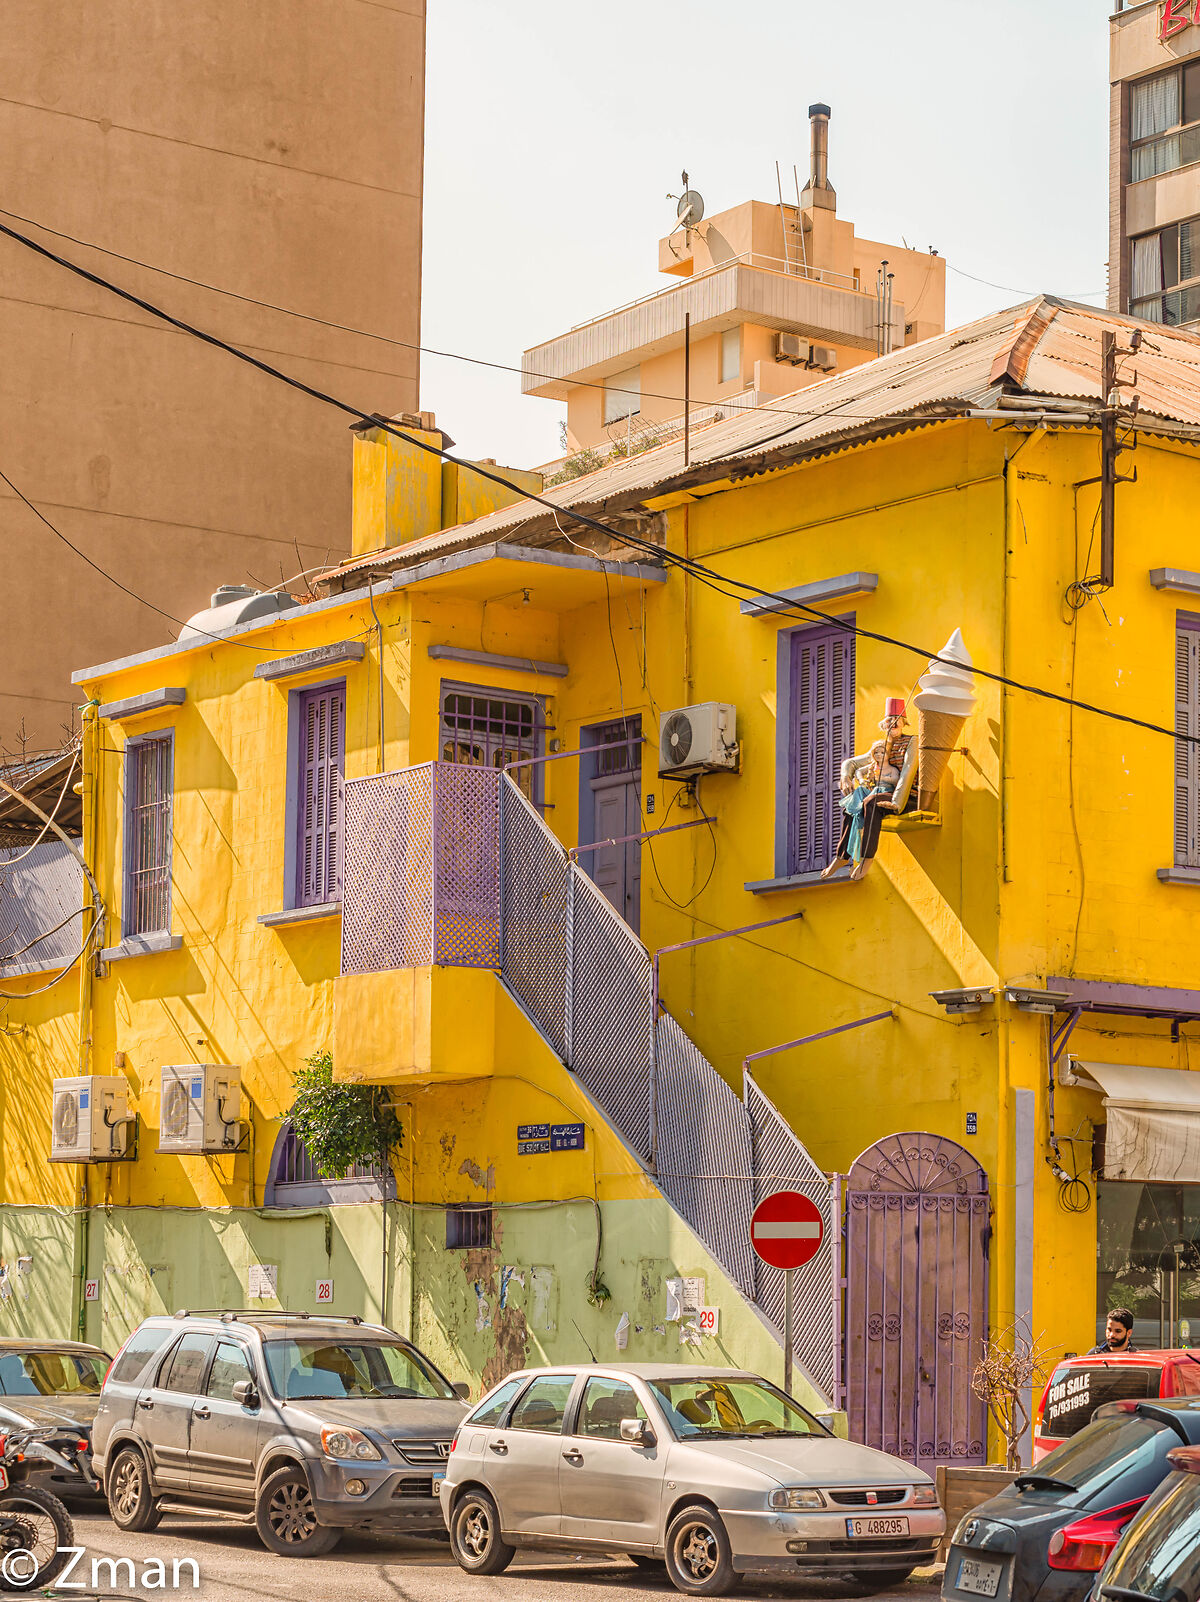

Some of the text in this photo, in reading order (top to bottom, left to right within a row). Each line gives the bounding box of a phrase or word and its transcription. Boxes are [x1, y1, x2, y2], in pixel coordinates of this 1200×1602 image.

[86, 1283, 96, 1297] 27
[318, 1283, 330, 1299] 28
[700, 1311, 715, 1329] 29
[1049, 1373, 1091, 1404] FOR SALE
[1049, 1391, 1090, 1420] 76/931993
[855, 1519, 903, 1535] G 488295
